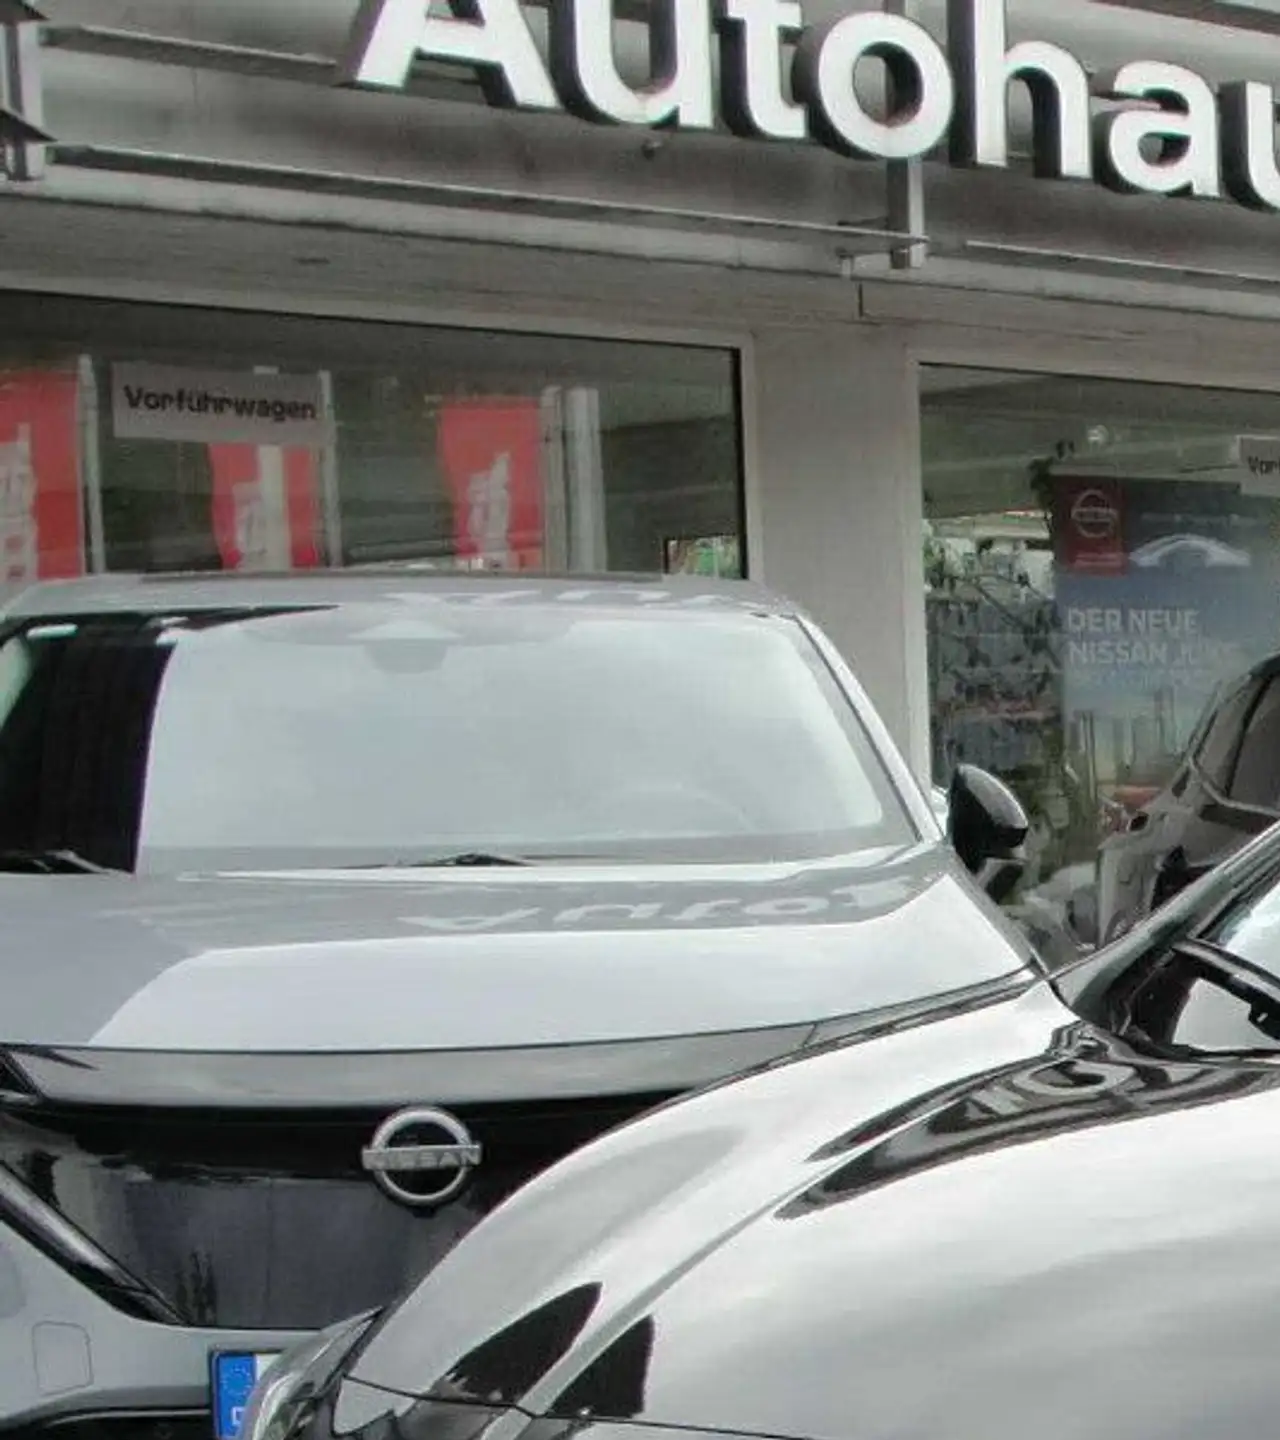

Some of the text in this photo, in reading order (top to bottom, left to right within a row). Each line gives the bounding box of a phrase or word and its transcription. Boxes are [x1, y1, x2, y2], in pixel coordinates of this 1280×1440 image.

[123, 385, 317, 422] Vorführwagen
[1067, 607, 1200, 633] DER NEUE
[1068, 640, 1168, 665] NISSAN
